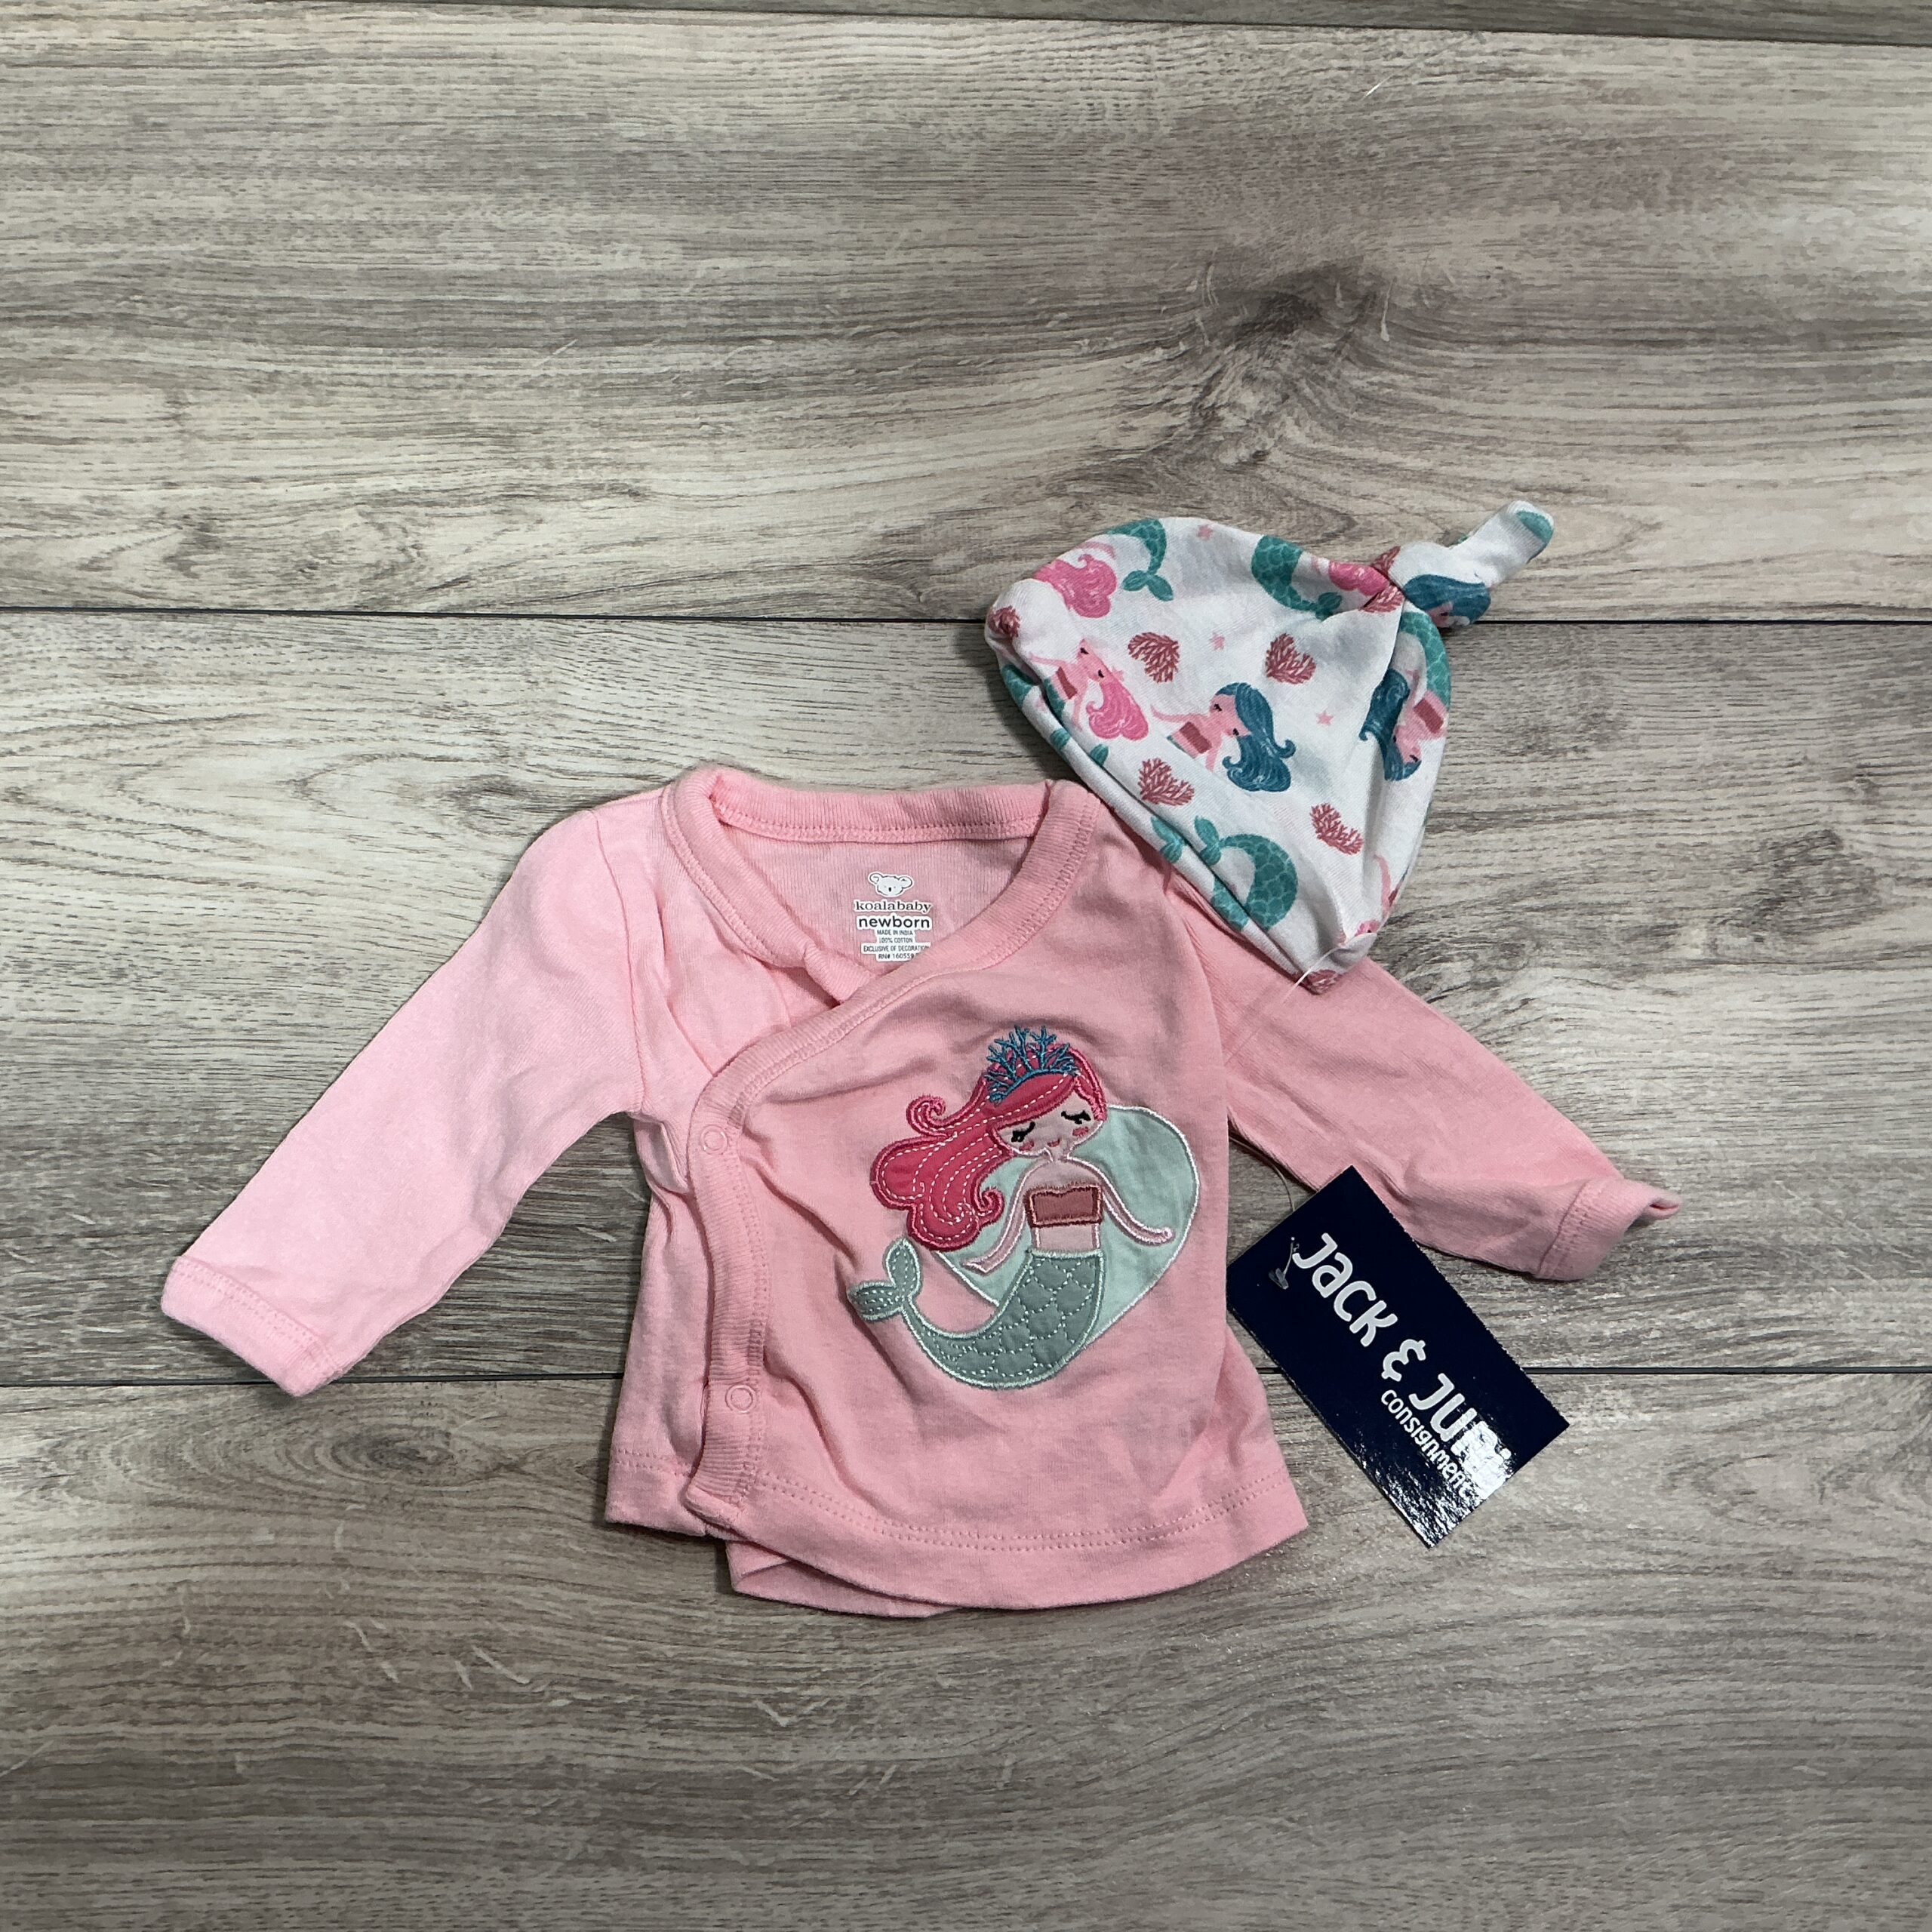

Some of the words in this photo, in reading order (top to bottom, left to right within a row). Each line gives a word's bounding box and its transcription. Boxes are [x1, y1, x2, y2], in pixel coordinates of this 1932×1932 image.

[856, 901, 931, 913] koalababy
[859, 915, 930, 928] newborn
[1381, 1338, 1426, 1382] &
[1380, 1389, 1475, 1500] consignment
